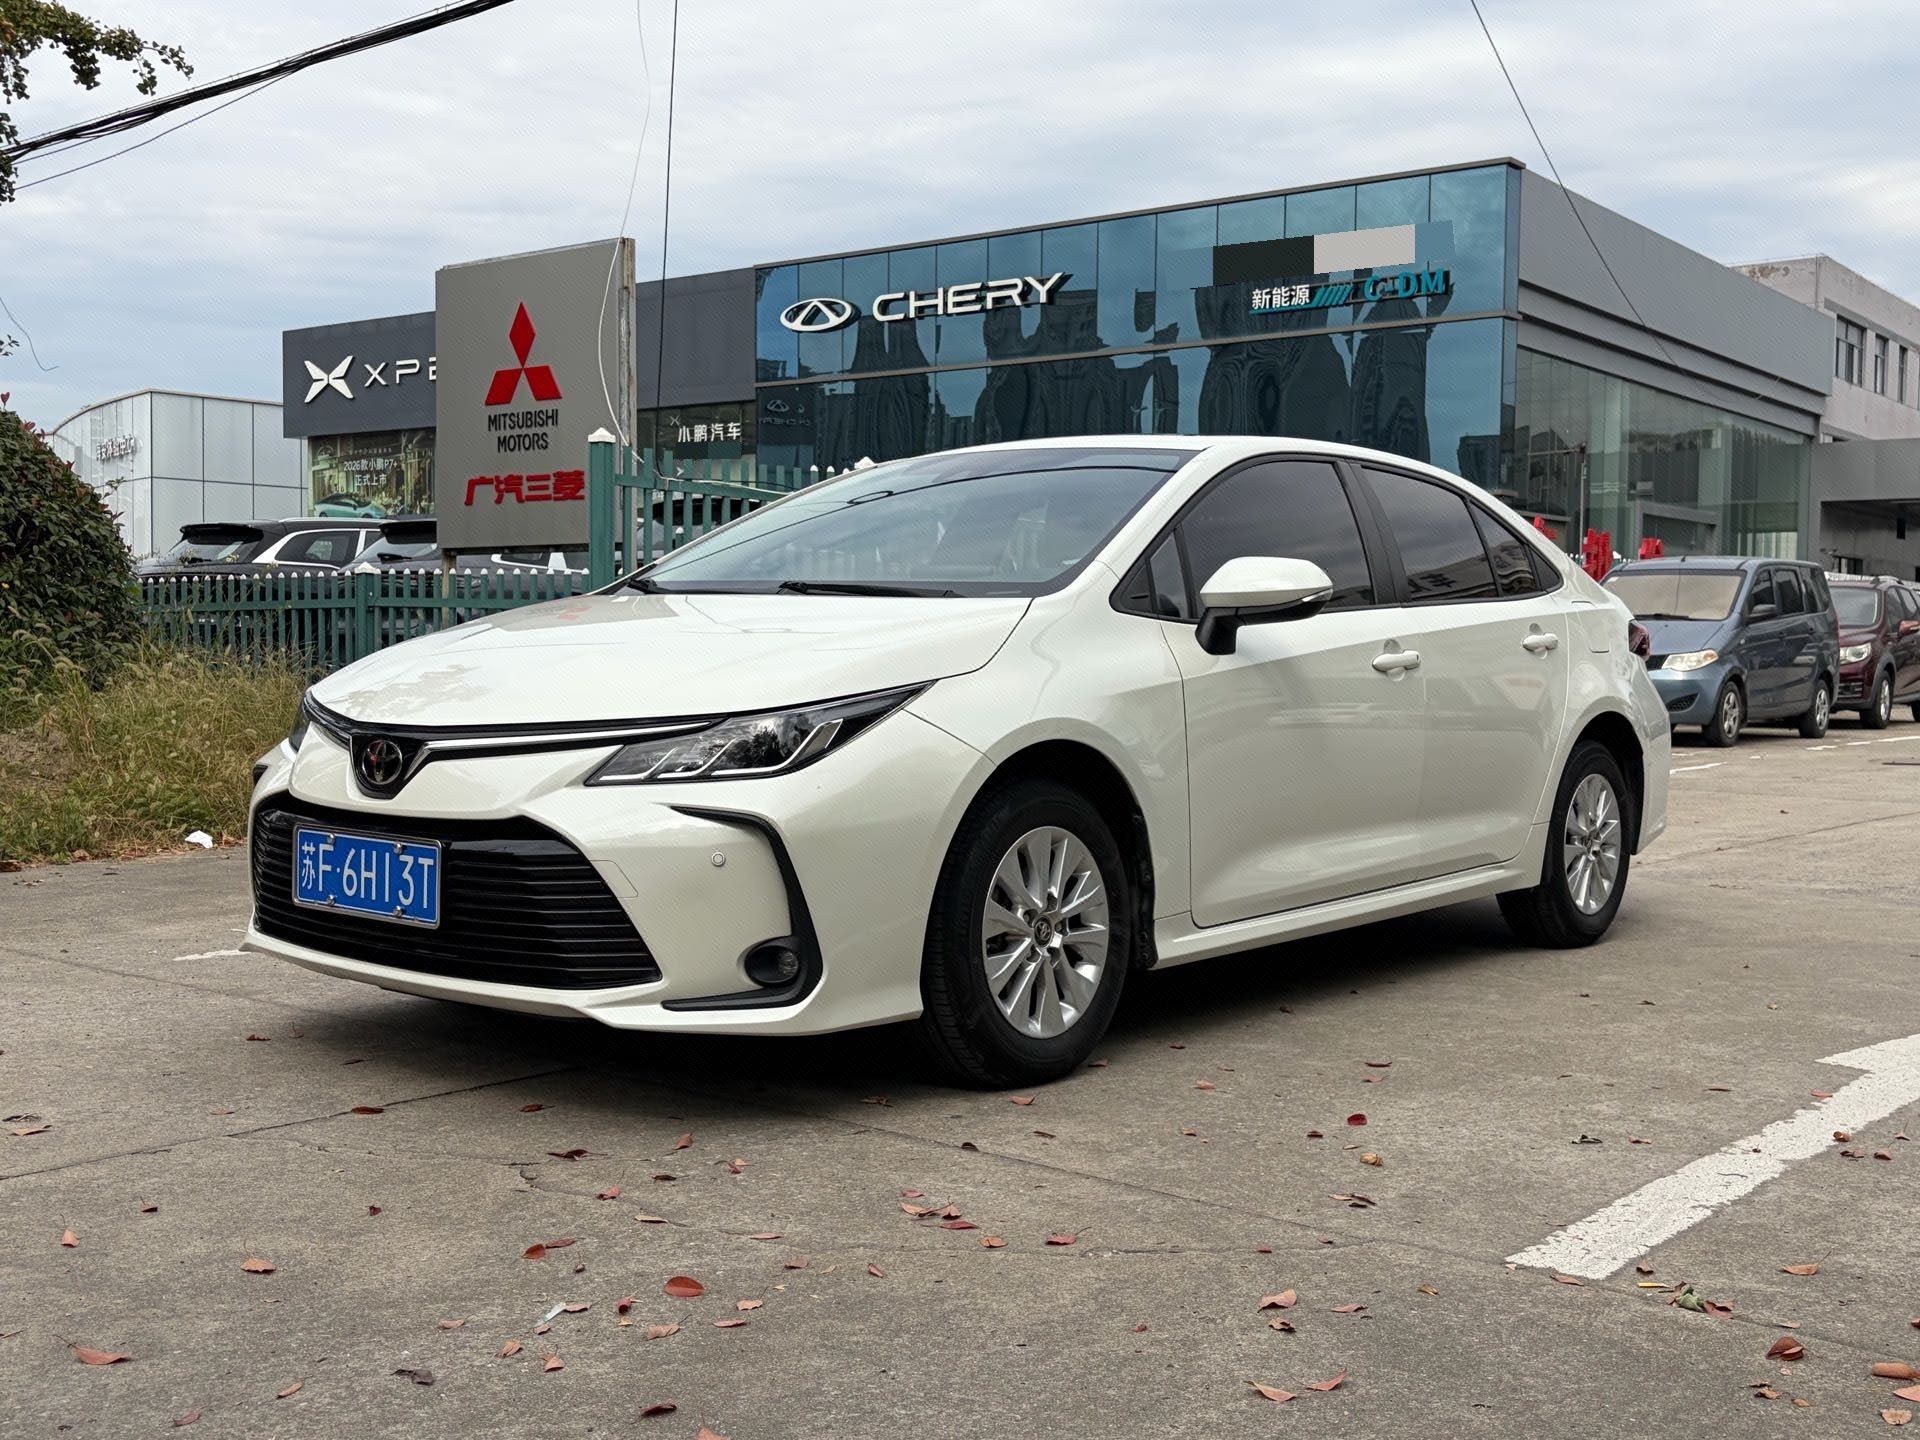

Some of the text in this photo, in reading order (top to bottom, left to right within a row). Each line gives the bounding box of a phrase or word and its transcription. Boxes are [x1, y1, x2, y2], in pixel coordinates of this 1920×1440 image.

[872, 272, 1065, 322] CHERY
[1251, 284, 1311, 310] 新能源
[487, 408, 560, 432] MITSUBISHI
[496, 432, 550, 453] MOTORS
[677, 422, 742, 443] 小鹏汽车
[354, 473, 388, 487] 正式上市
[463, 469, 586, 507] 广汽三菱
